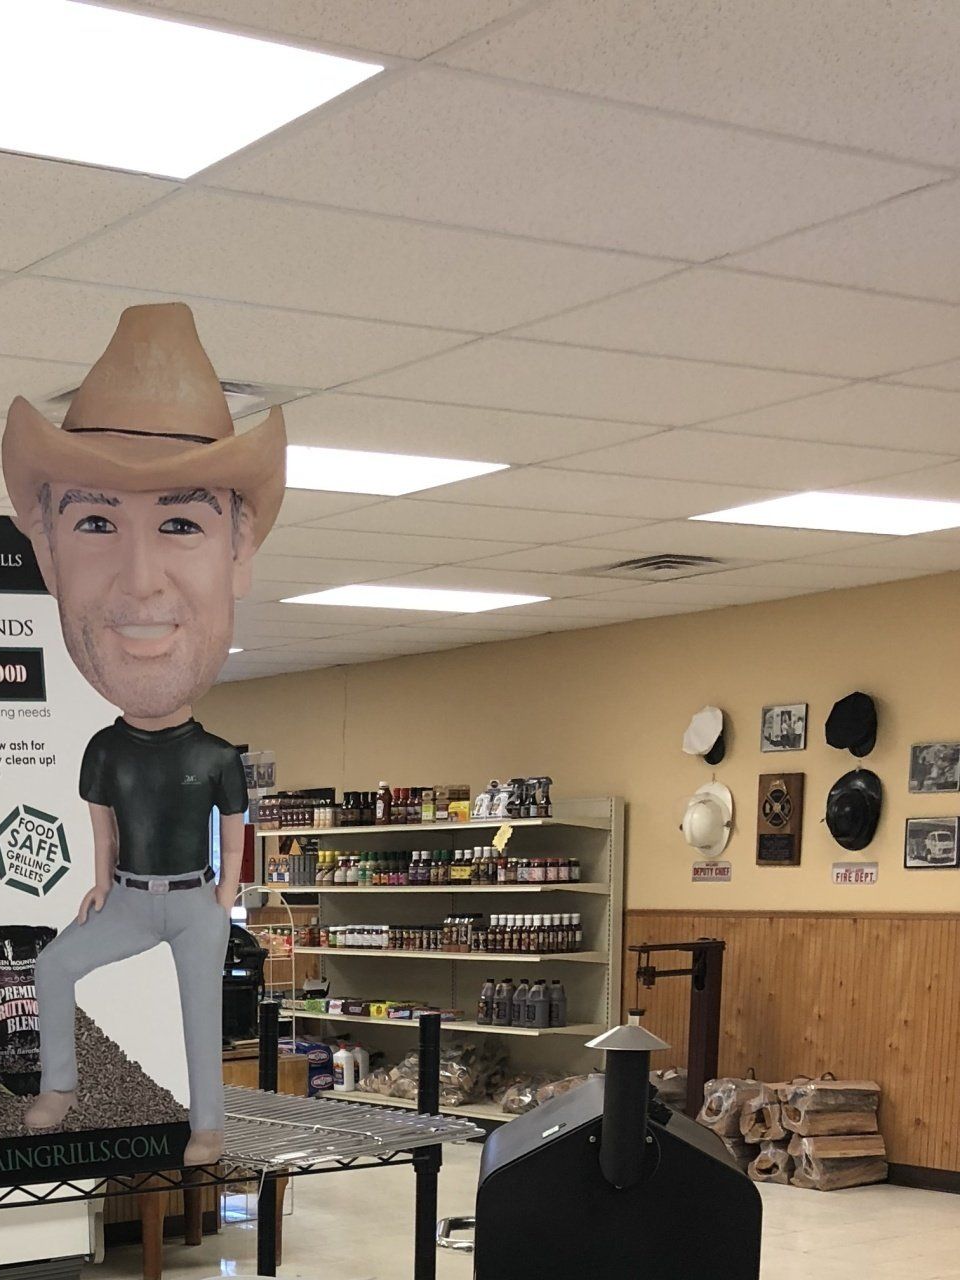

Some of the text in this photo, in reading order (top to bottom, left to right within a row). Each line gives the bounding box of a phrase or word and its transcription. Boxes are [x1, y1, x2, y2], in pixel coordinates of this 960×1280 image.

[18, 707, 51, 718] needs
[10, 740, 28, 750] ash
[31, 740, 45, 751] for
[5, 755, 36, 764] clean
[39, 756, 55, 766] up!
[19, 817, 54, 840] FOOD
[8, 829, 58, 864] SAFE
[7, 850, 51, 874] GRILLING
[9, 863, 43, 883] PELLETS
[694, 867, 729, 876] DEPUTY CHIEF
[836, 872, 851, 882] FIRE
